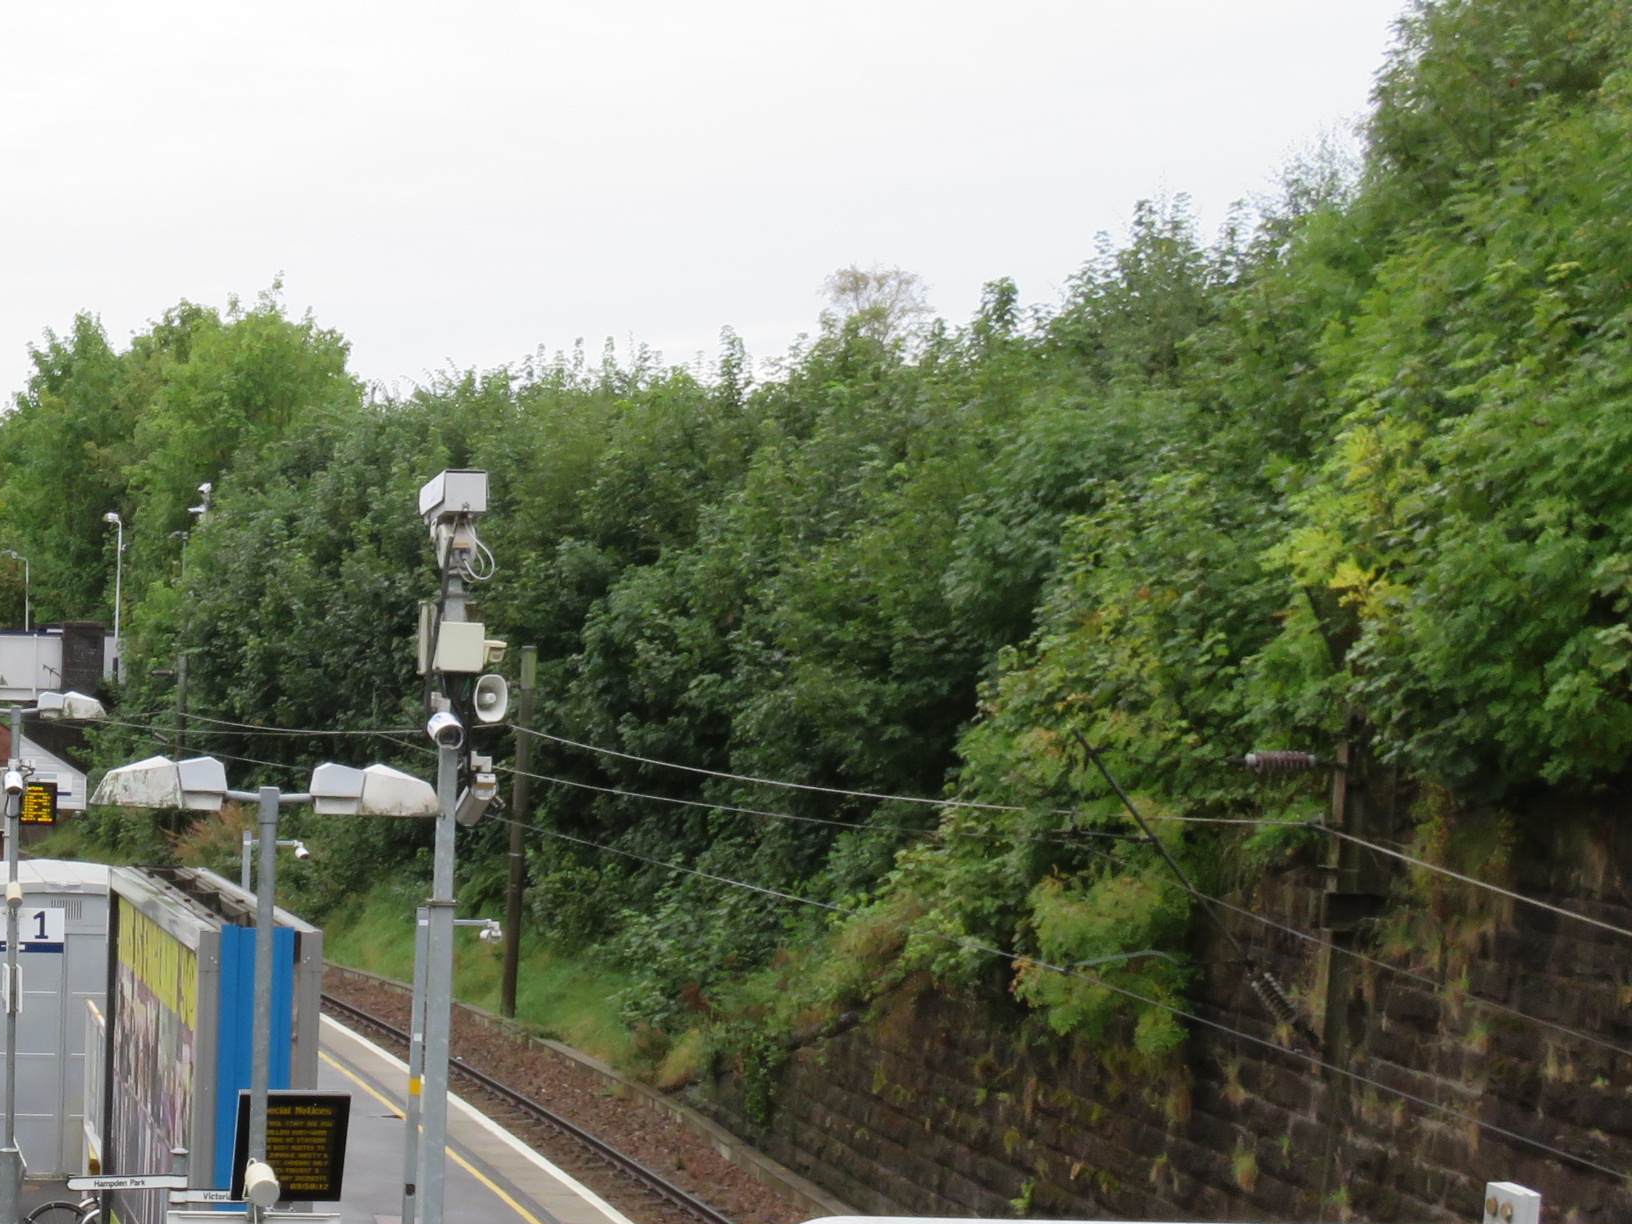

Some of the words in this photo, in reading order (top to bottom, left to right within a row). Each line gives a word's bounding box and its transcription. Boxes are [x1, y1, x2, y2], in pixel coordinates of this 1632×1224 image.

[33, 910, 49, 939] 1
[267, 1107, 291, 1115] ecial
[295, 1106, 332, 1115] Notices
[94, 1180, 128, 1188] Hampden
[130, 1179, 146, 1187] Park
